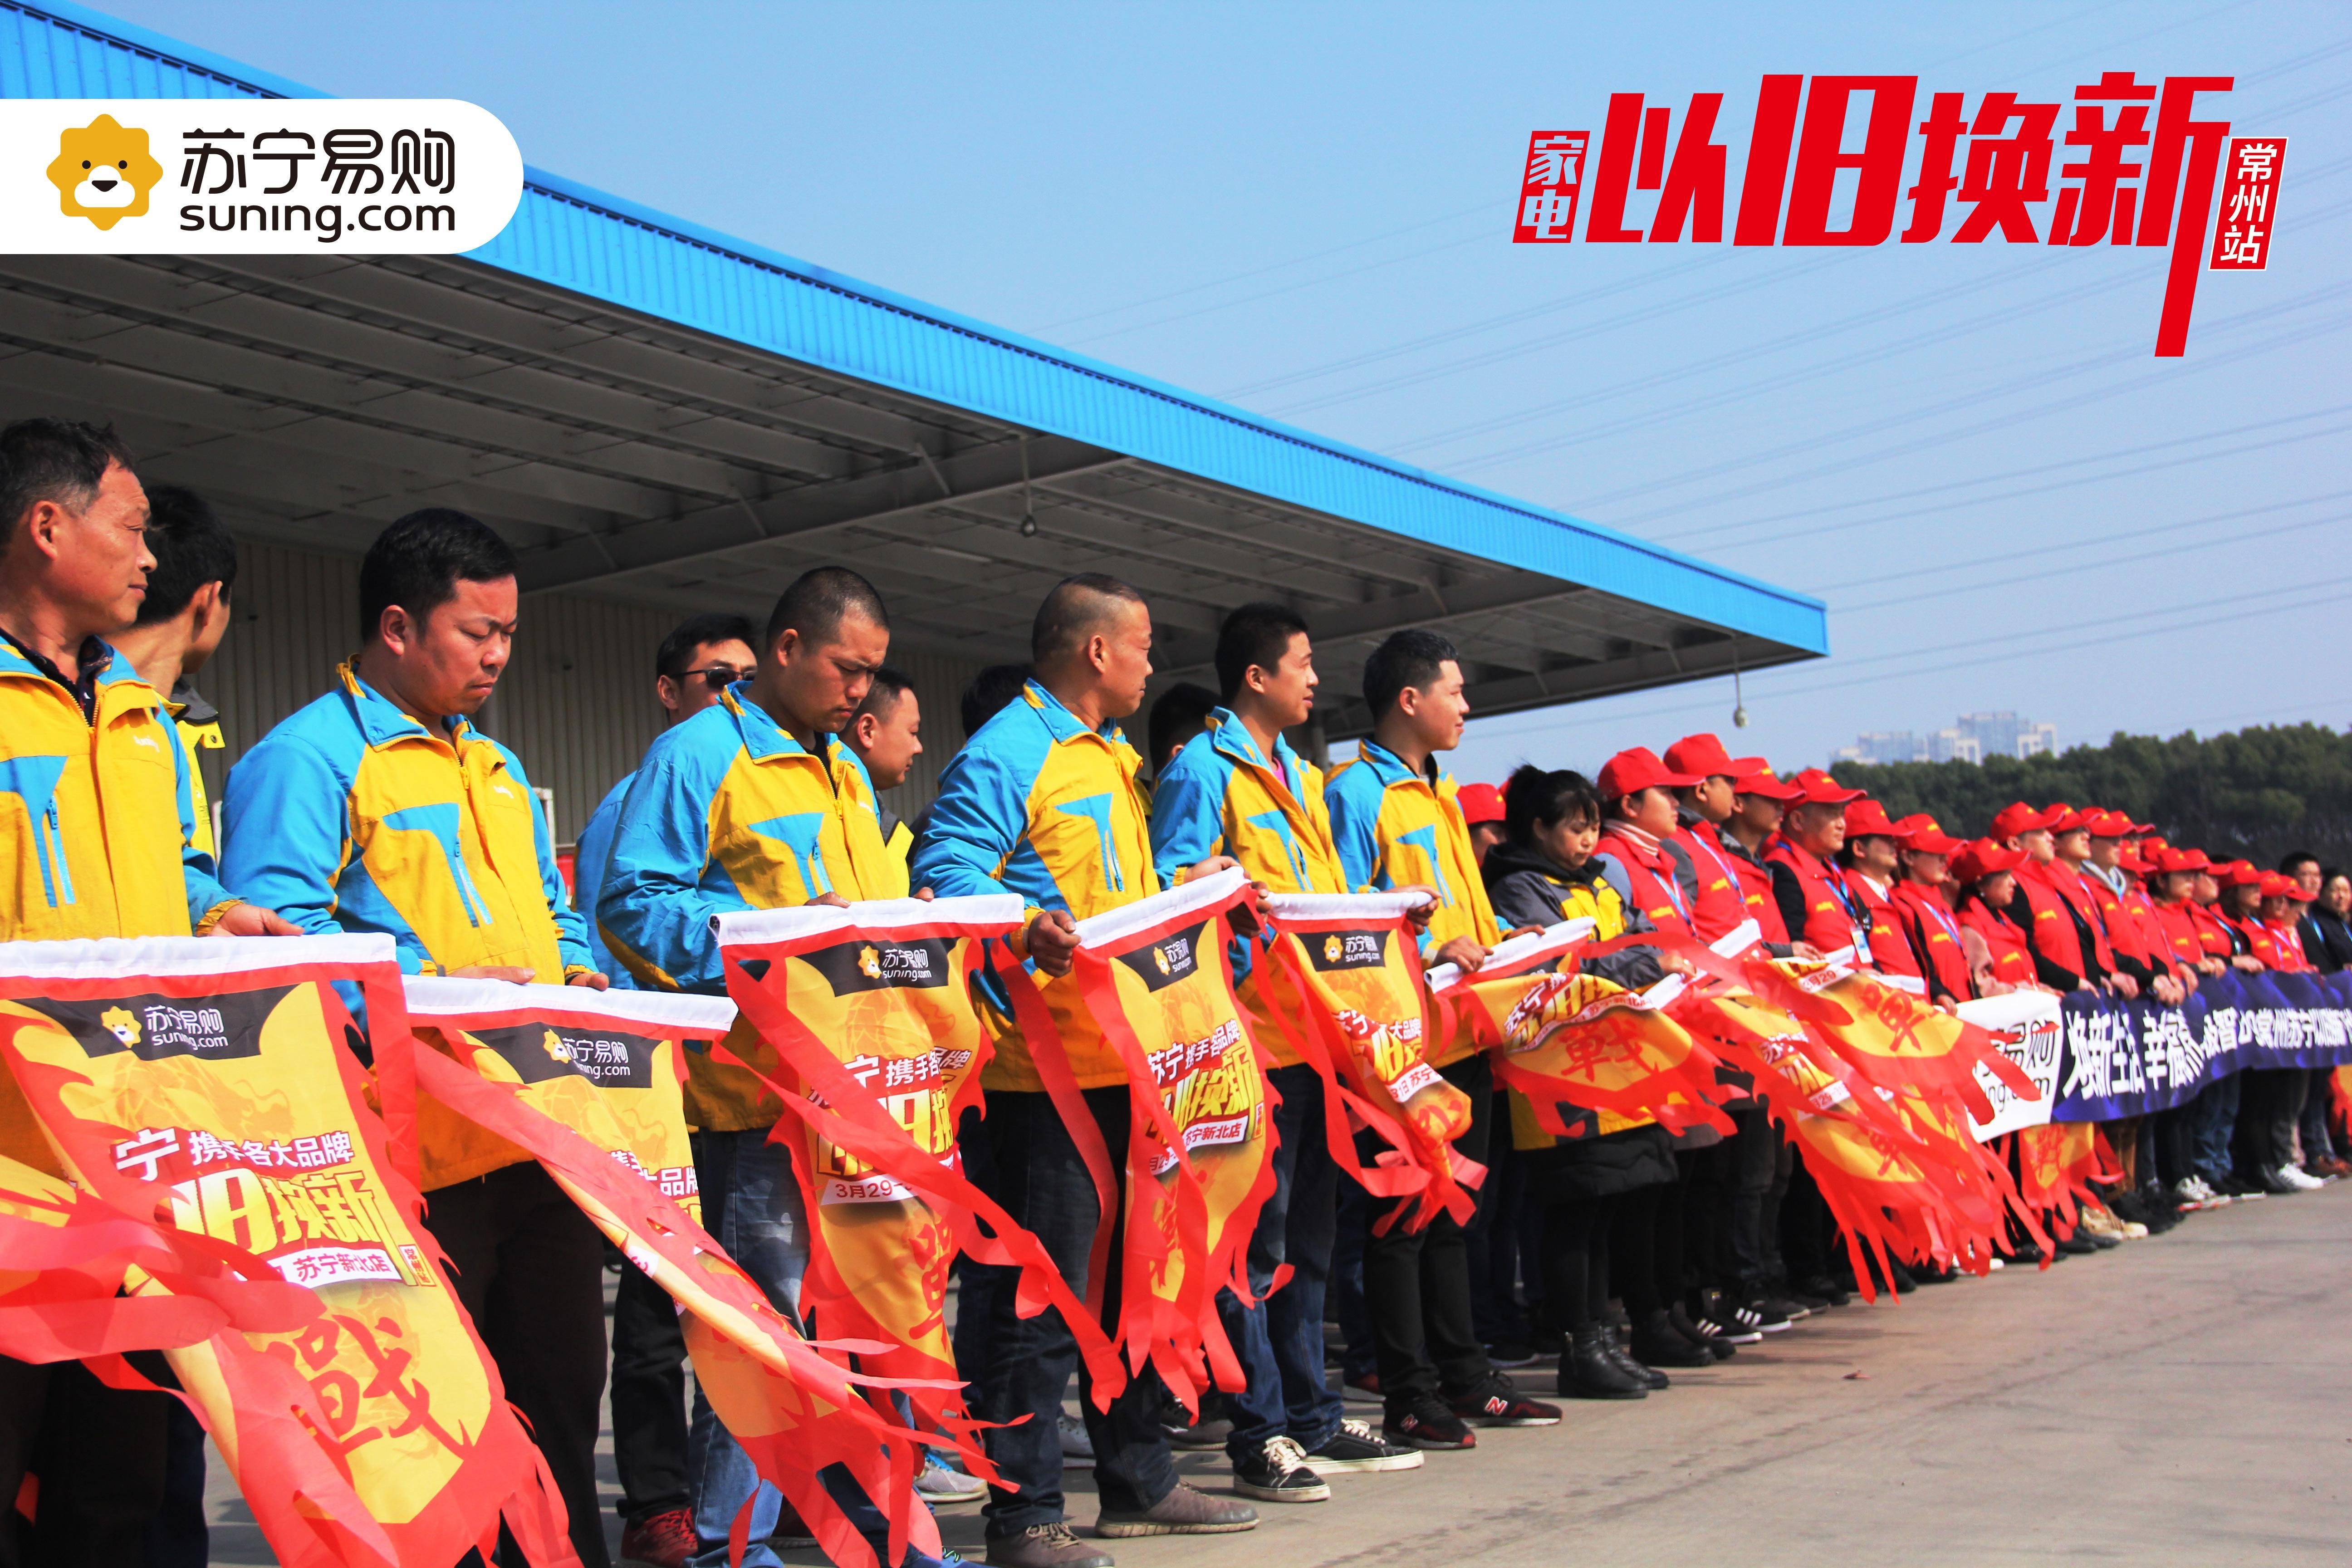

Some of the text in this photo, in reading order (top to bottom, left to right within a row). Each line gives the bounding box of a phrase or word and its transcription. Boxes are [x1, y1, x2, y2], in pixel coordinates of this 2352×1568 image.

[882, 948, 929, 968] 苏宁易购
[882, 969, 932, 982] suning.com
[143, 1004, 225, 1034] 苏宁易购
[152, 1031, 229, 1051] suning.com
[562, 1037, 629, 1064] 苏宁易购
[1185, 1122, 1242, 1146] 苏宁新北店
[189, 1131, 355, 1168] 携手各大品牌
[293, 1253, 392, 1282] 苏宁新北店
